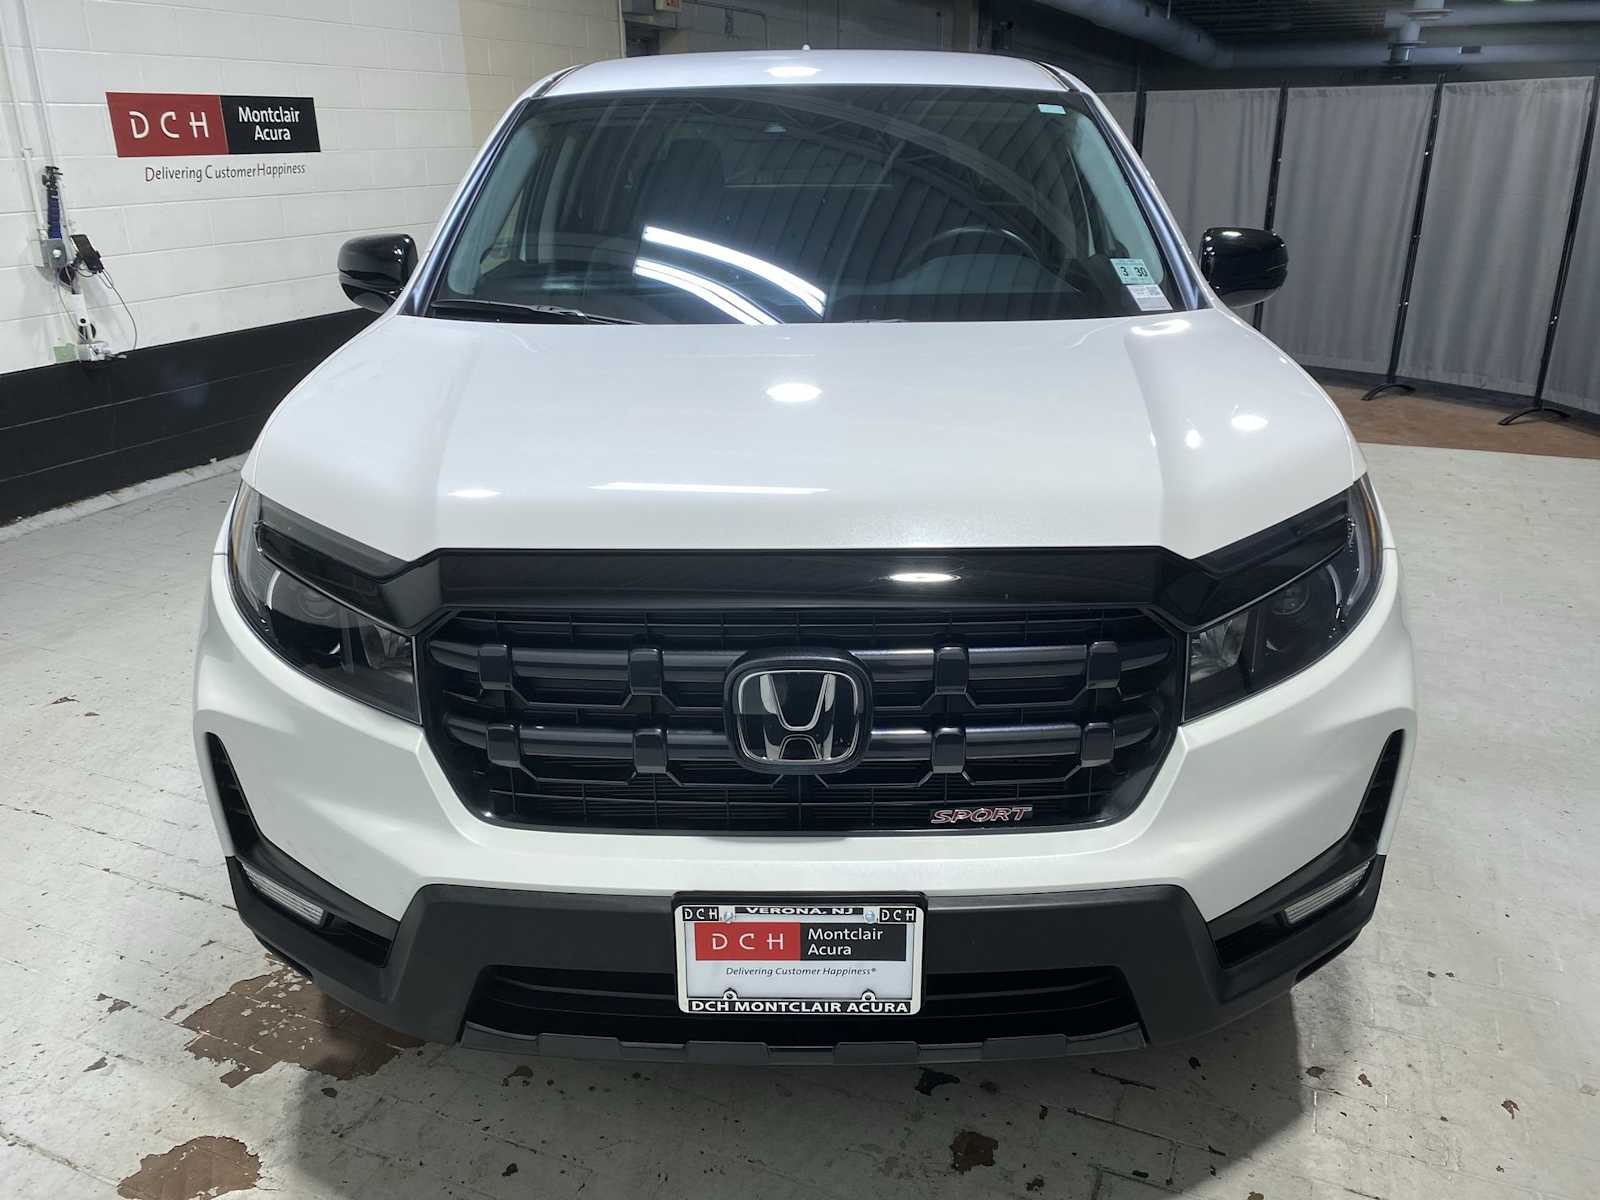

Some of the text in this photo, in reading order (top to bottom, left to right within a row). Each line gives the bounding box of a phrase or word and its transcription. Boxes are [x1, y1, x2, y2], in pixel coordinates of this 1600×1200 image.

[238, 106, 301, 124] Montclair
[254, 125, 292, 142] Acura
[144, 166, 203, 183] Delivering
[930, 806, 1033, 824] SPORT
[683, 907, 719, 920] DCH
[831, 907, 854, 915] NJ
[880, 909, 915, 921] DCH
[807, 927, 884, 941] Montclair
[711, 932, 785, 951] DCH
[807, 943, 853, 956] Acura
[725, 967, 773, 978] Delivering
[774, 967, 820, 976] Customer
[691, 1001, 909, 1013] DCH MONTCLAIR ACURA
